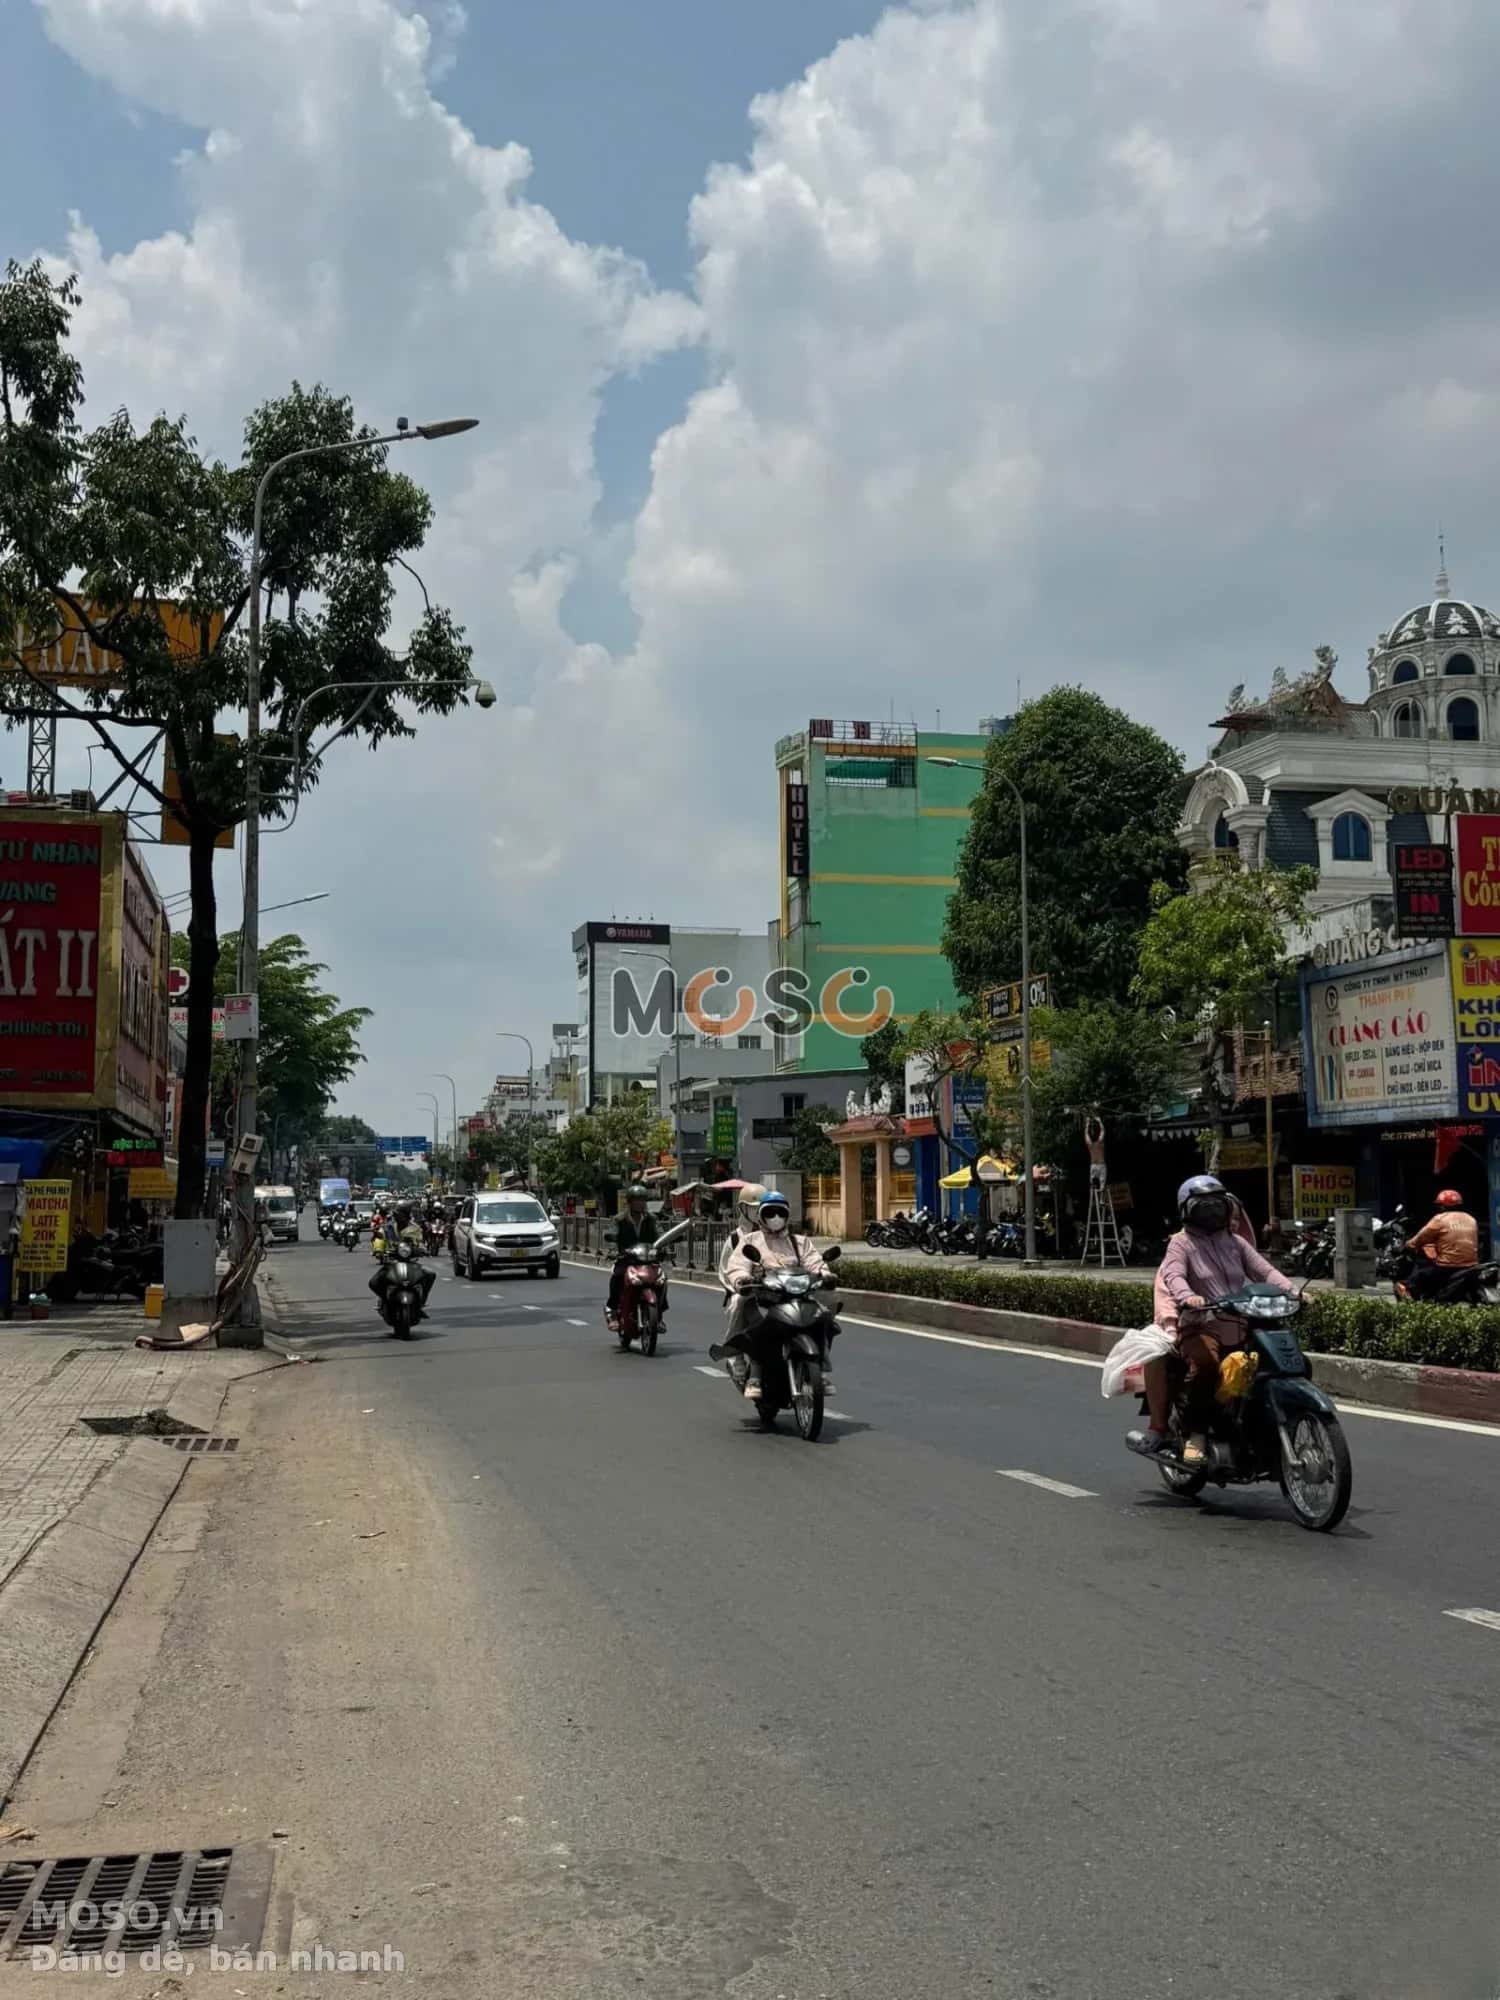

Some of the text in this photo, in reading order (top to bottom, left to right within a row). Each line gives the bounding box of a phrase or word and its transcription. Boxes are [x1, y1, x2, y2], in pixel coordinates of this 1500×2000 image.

[791, 787, 804, 874] HOTEL
[1398, 848, 1446, 870] LED
[1410, 893, 1440, 913] IN
[1328, 1008, 1431, 1047] QUẢNG CÁO
[31, 1215, 60, 1226] LATTE
[33, 1230, 56, 1241] 20K
